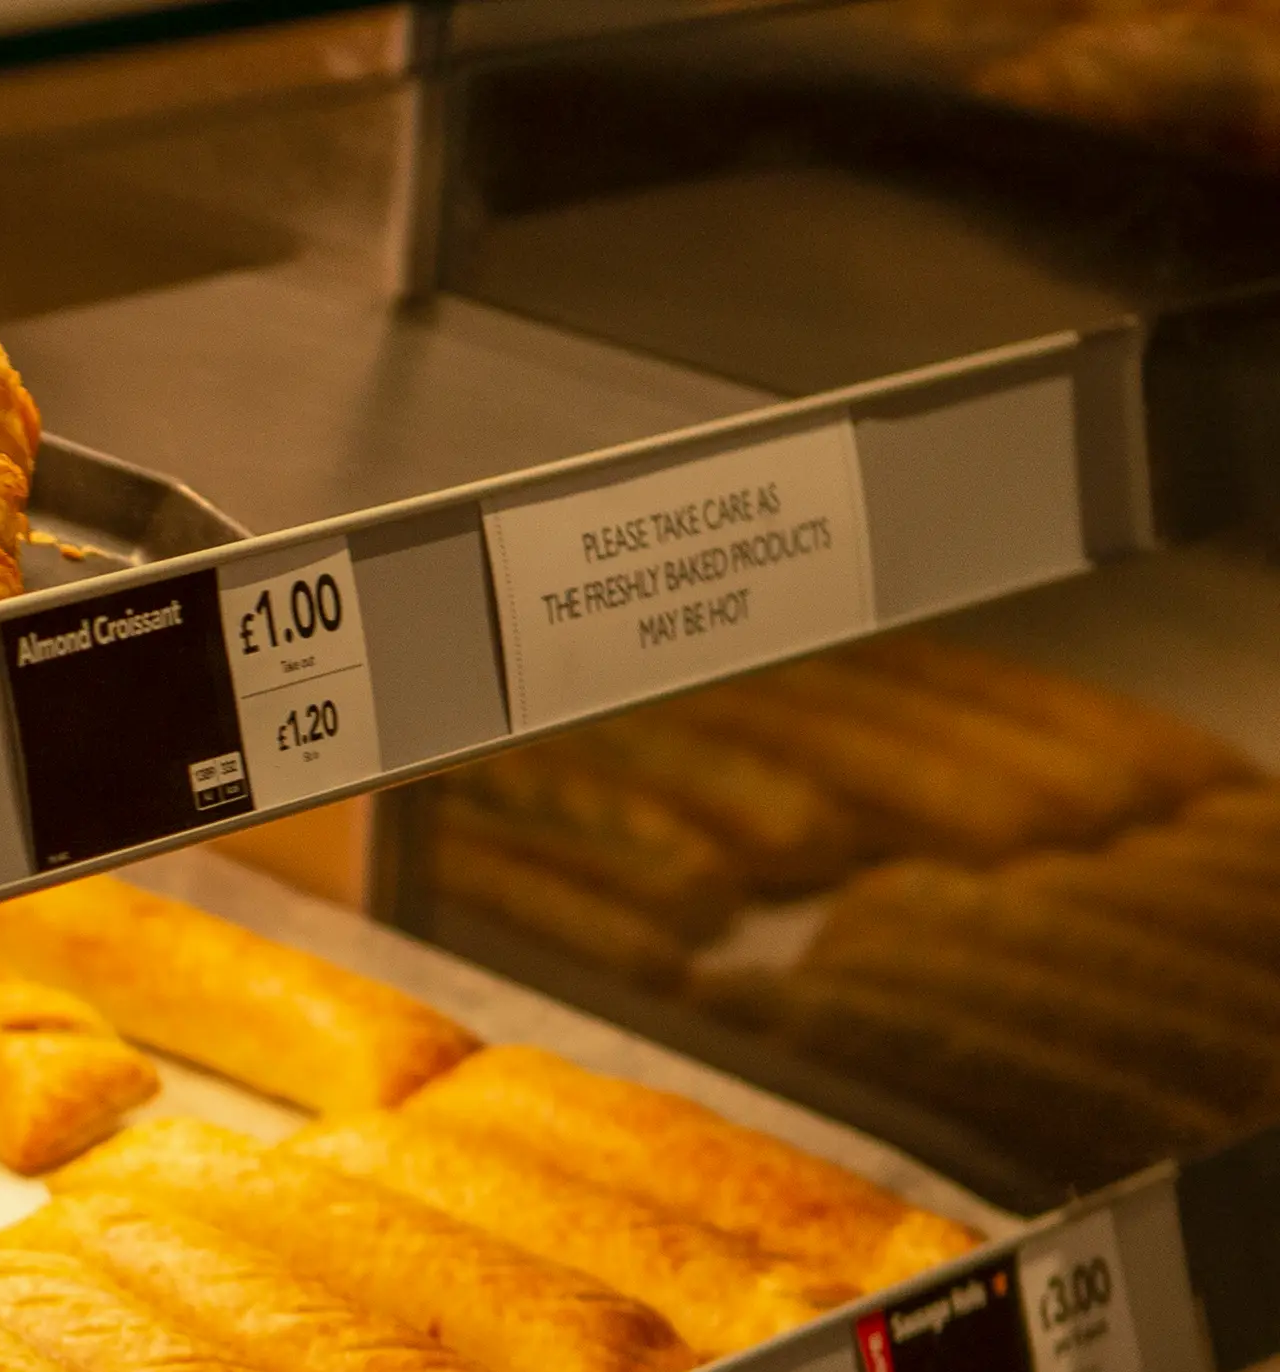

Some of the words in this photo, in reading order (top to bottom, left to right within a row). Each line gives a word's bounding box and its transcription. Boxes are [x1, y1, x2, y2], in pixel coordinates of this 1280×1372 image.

[582, 517, 650, 563] PLEASE
[650, 503, 700, 545] TAKE
[702, 491, 754, 531] CARE
[756, 482, 782, 515] AS
[541, 587, 583, 625] THE
[584, 565, 661, 613] FRESHLY
[665, 548, 728, 593] BAKED
[731, 516, 833, 573] PRODUCTS
[17, 618, 92, 668] Almond
[93, 599, 184, 645] Croissant
[240, 573, 342, 654] £1.00
[640, 608, 681, 648] MAY
[682, 600, 707, 637] BE
[708, 588, 752, 628] HOT
[277, 699, 338, 751] £1.20
